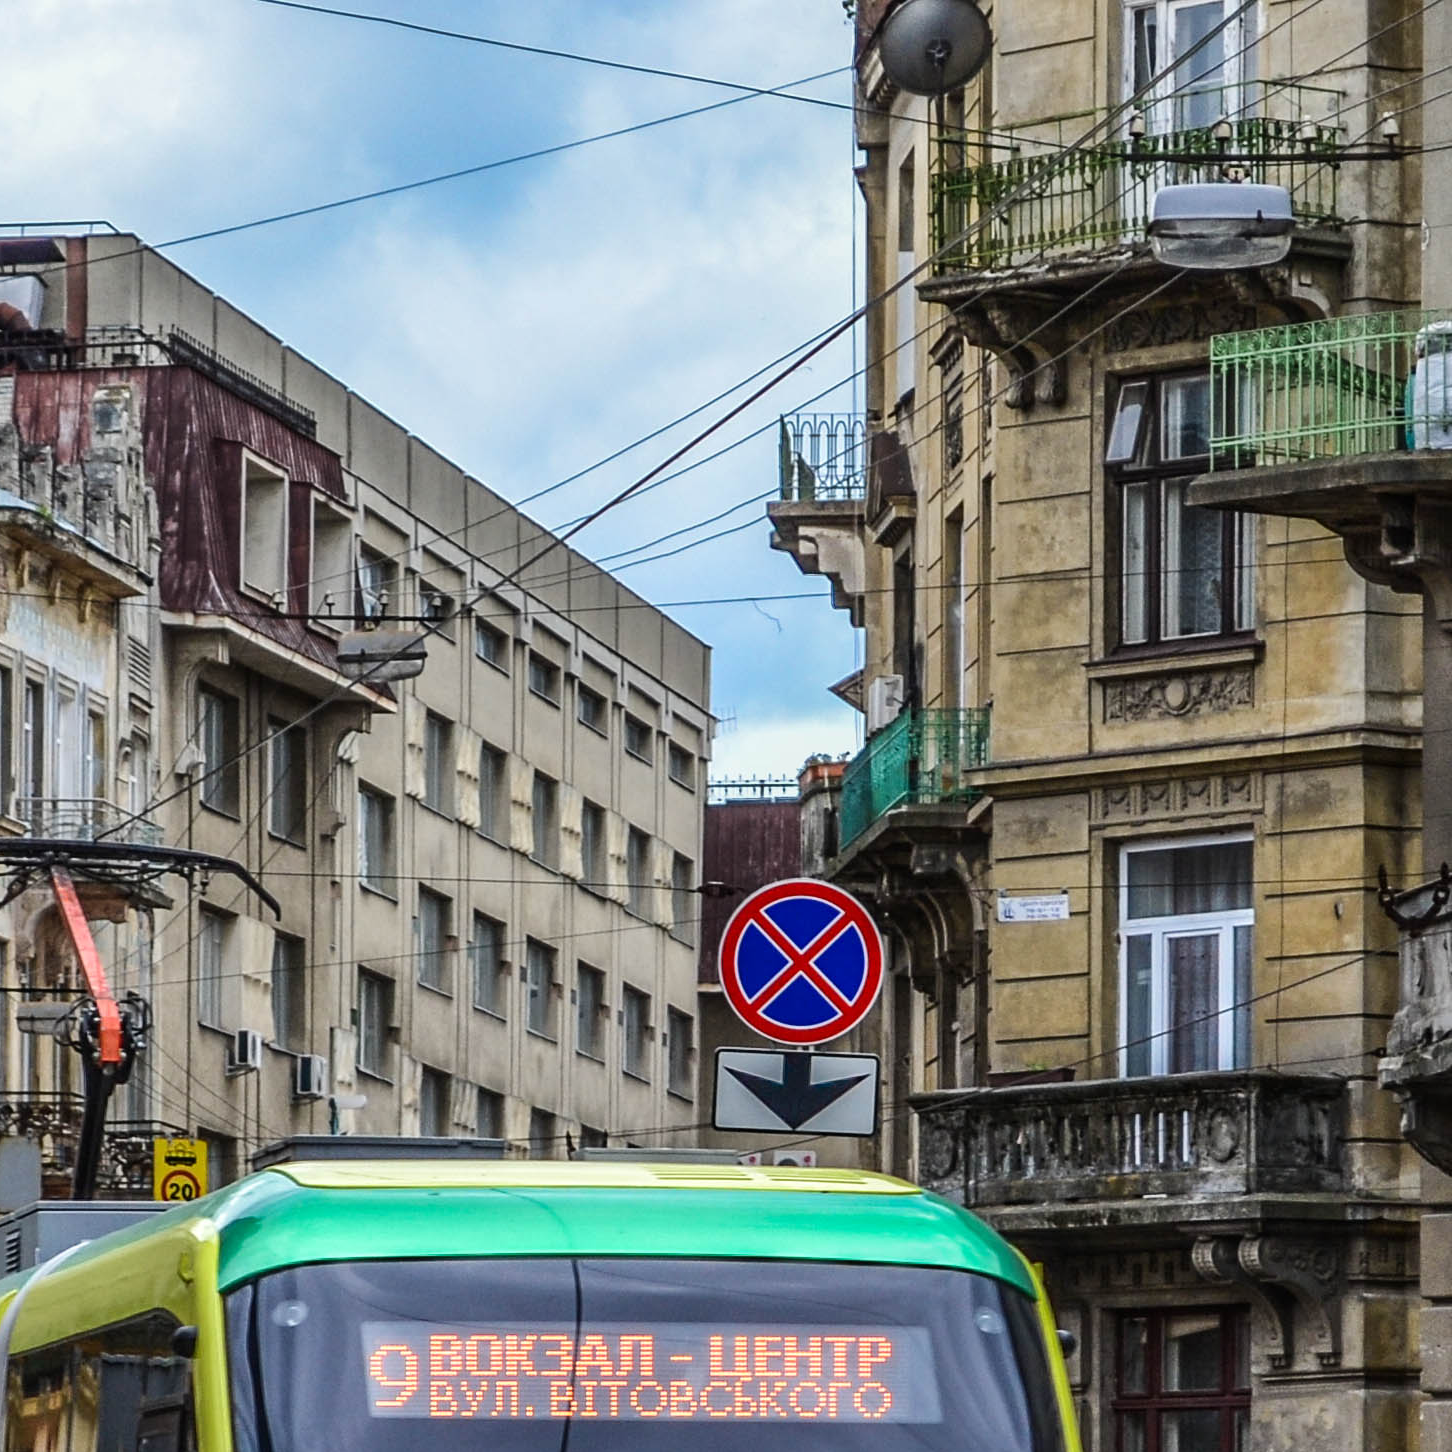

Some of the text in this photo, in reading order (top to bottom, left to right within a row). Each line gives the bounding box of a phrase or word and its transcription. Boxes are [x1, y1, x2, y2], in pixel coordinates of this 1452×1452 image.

[168, 1182, 194, 1200] 20
[368, 1343, 420, 1408] 9
[428, 1333, 655, 1377] ВОКЗАЛ
[708, 1334, 893, 1381] ЦЕНТР
[428, 1380, 893, 1419] ВУЛ. ВІТОВСЬКОГО
